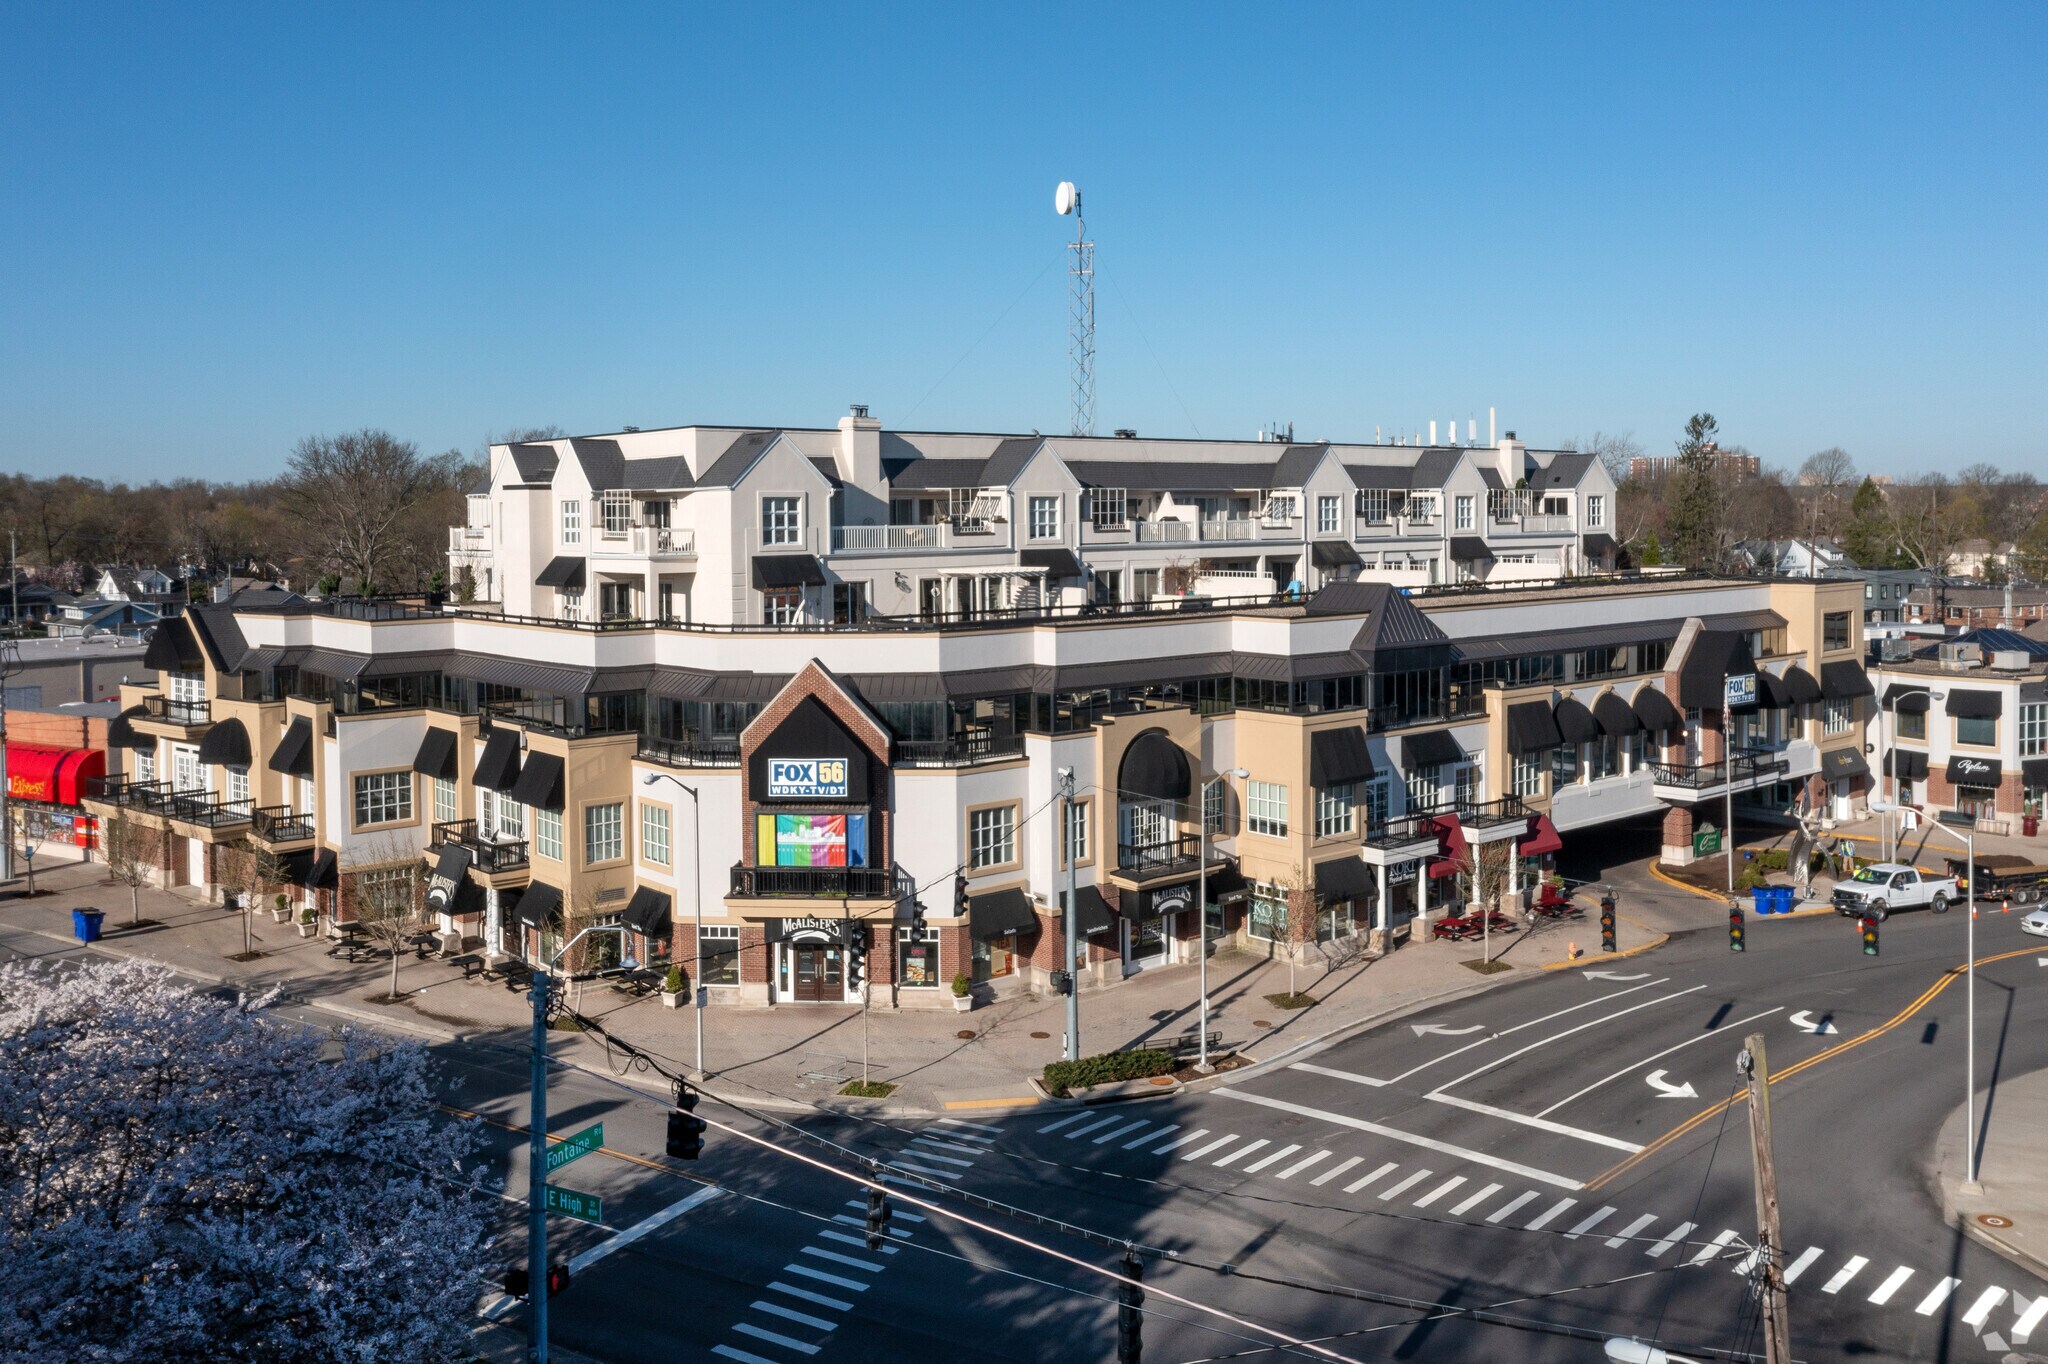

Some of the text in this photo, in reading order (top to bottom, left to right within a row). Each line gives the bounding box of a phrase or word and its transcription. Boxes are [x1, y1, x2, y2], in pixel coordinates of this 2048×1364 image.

[1729, 677, 1755, 693] FOX 56
[773, 761, 844, 784] FOX 56
[771, 785, 845, 795] WDKY-TV/DT
[1389, 859, 1417, 877] KORT
[1252, 899, 1288, 921] KOT
[546, 1137, 590, 1169] Fontaine
[549, 1190, 582, 1214] E High
